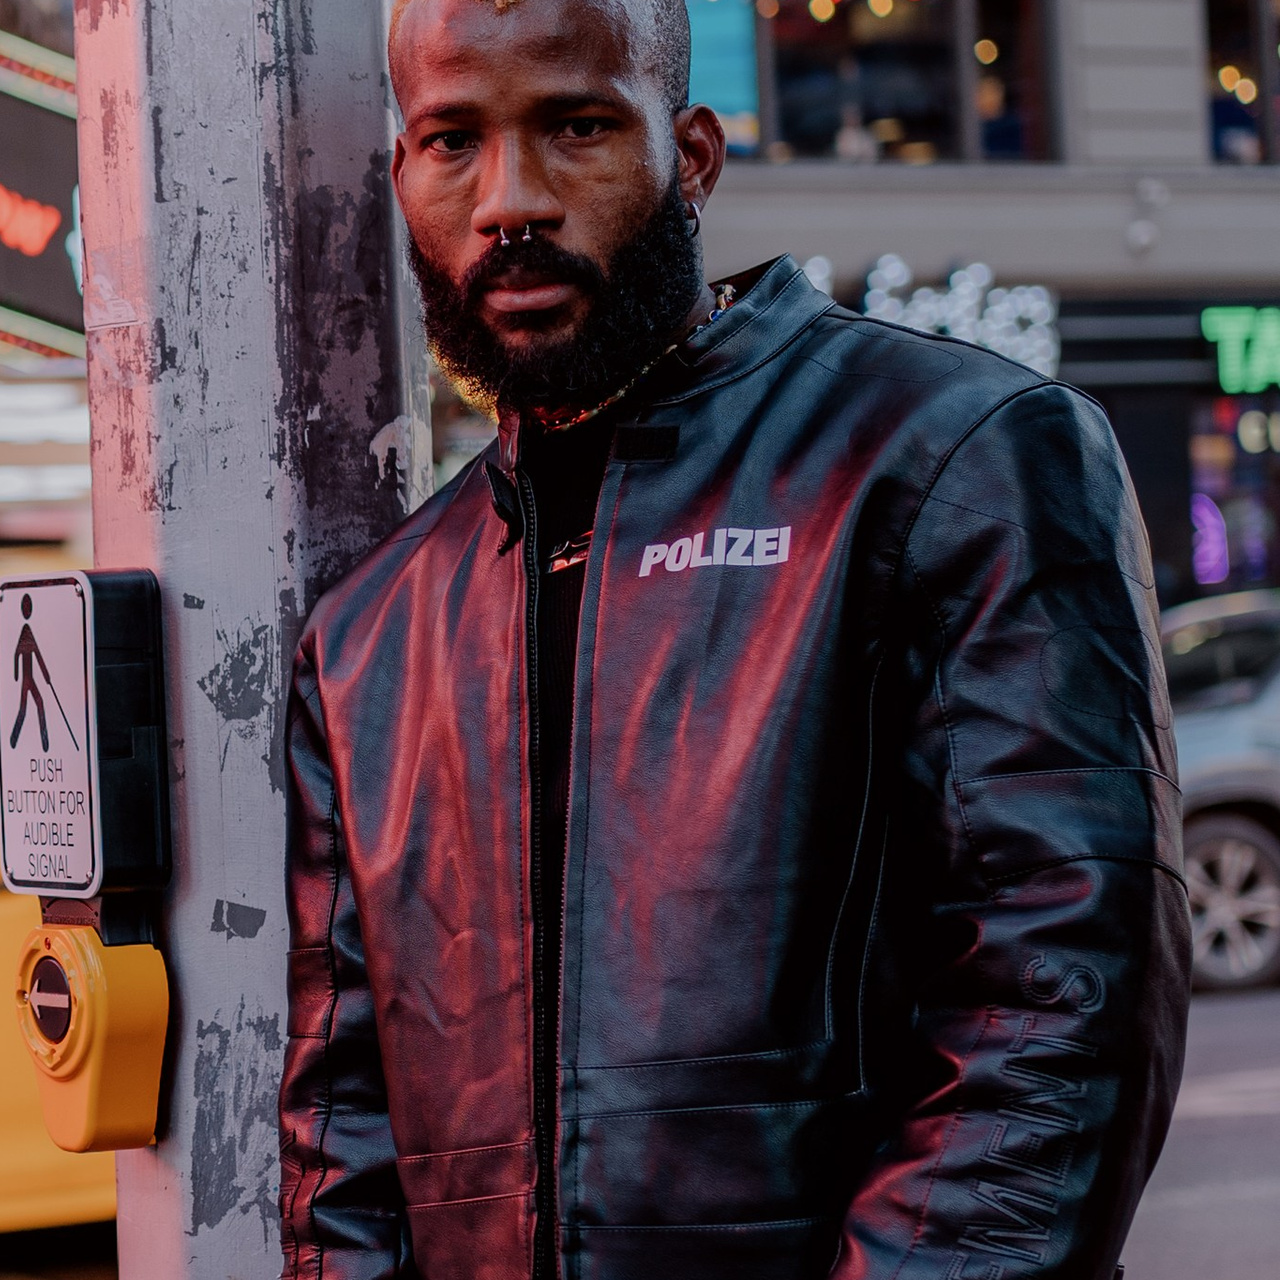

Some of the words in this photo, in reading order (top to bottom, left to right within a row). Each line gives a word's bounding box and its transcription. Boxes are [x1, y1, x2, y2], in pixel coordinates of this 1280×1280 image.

[638, 526, 792, 578] POLIZEI
[30, 758, 63, 783] PUSH
[7, 789, 56, 814] BUTTON
[59, 790, 86, 815] FOR
[23, 822, 75, 847] AUDIBLE
[28, 852, 73, 880] SIGNAL
